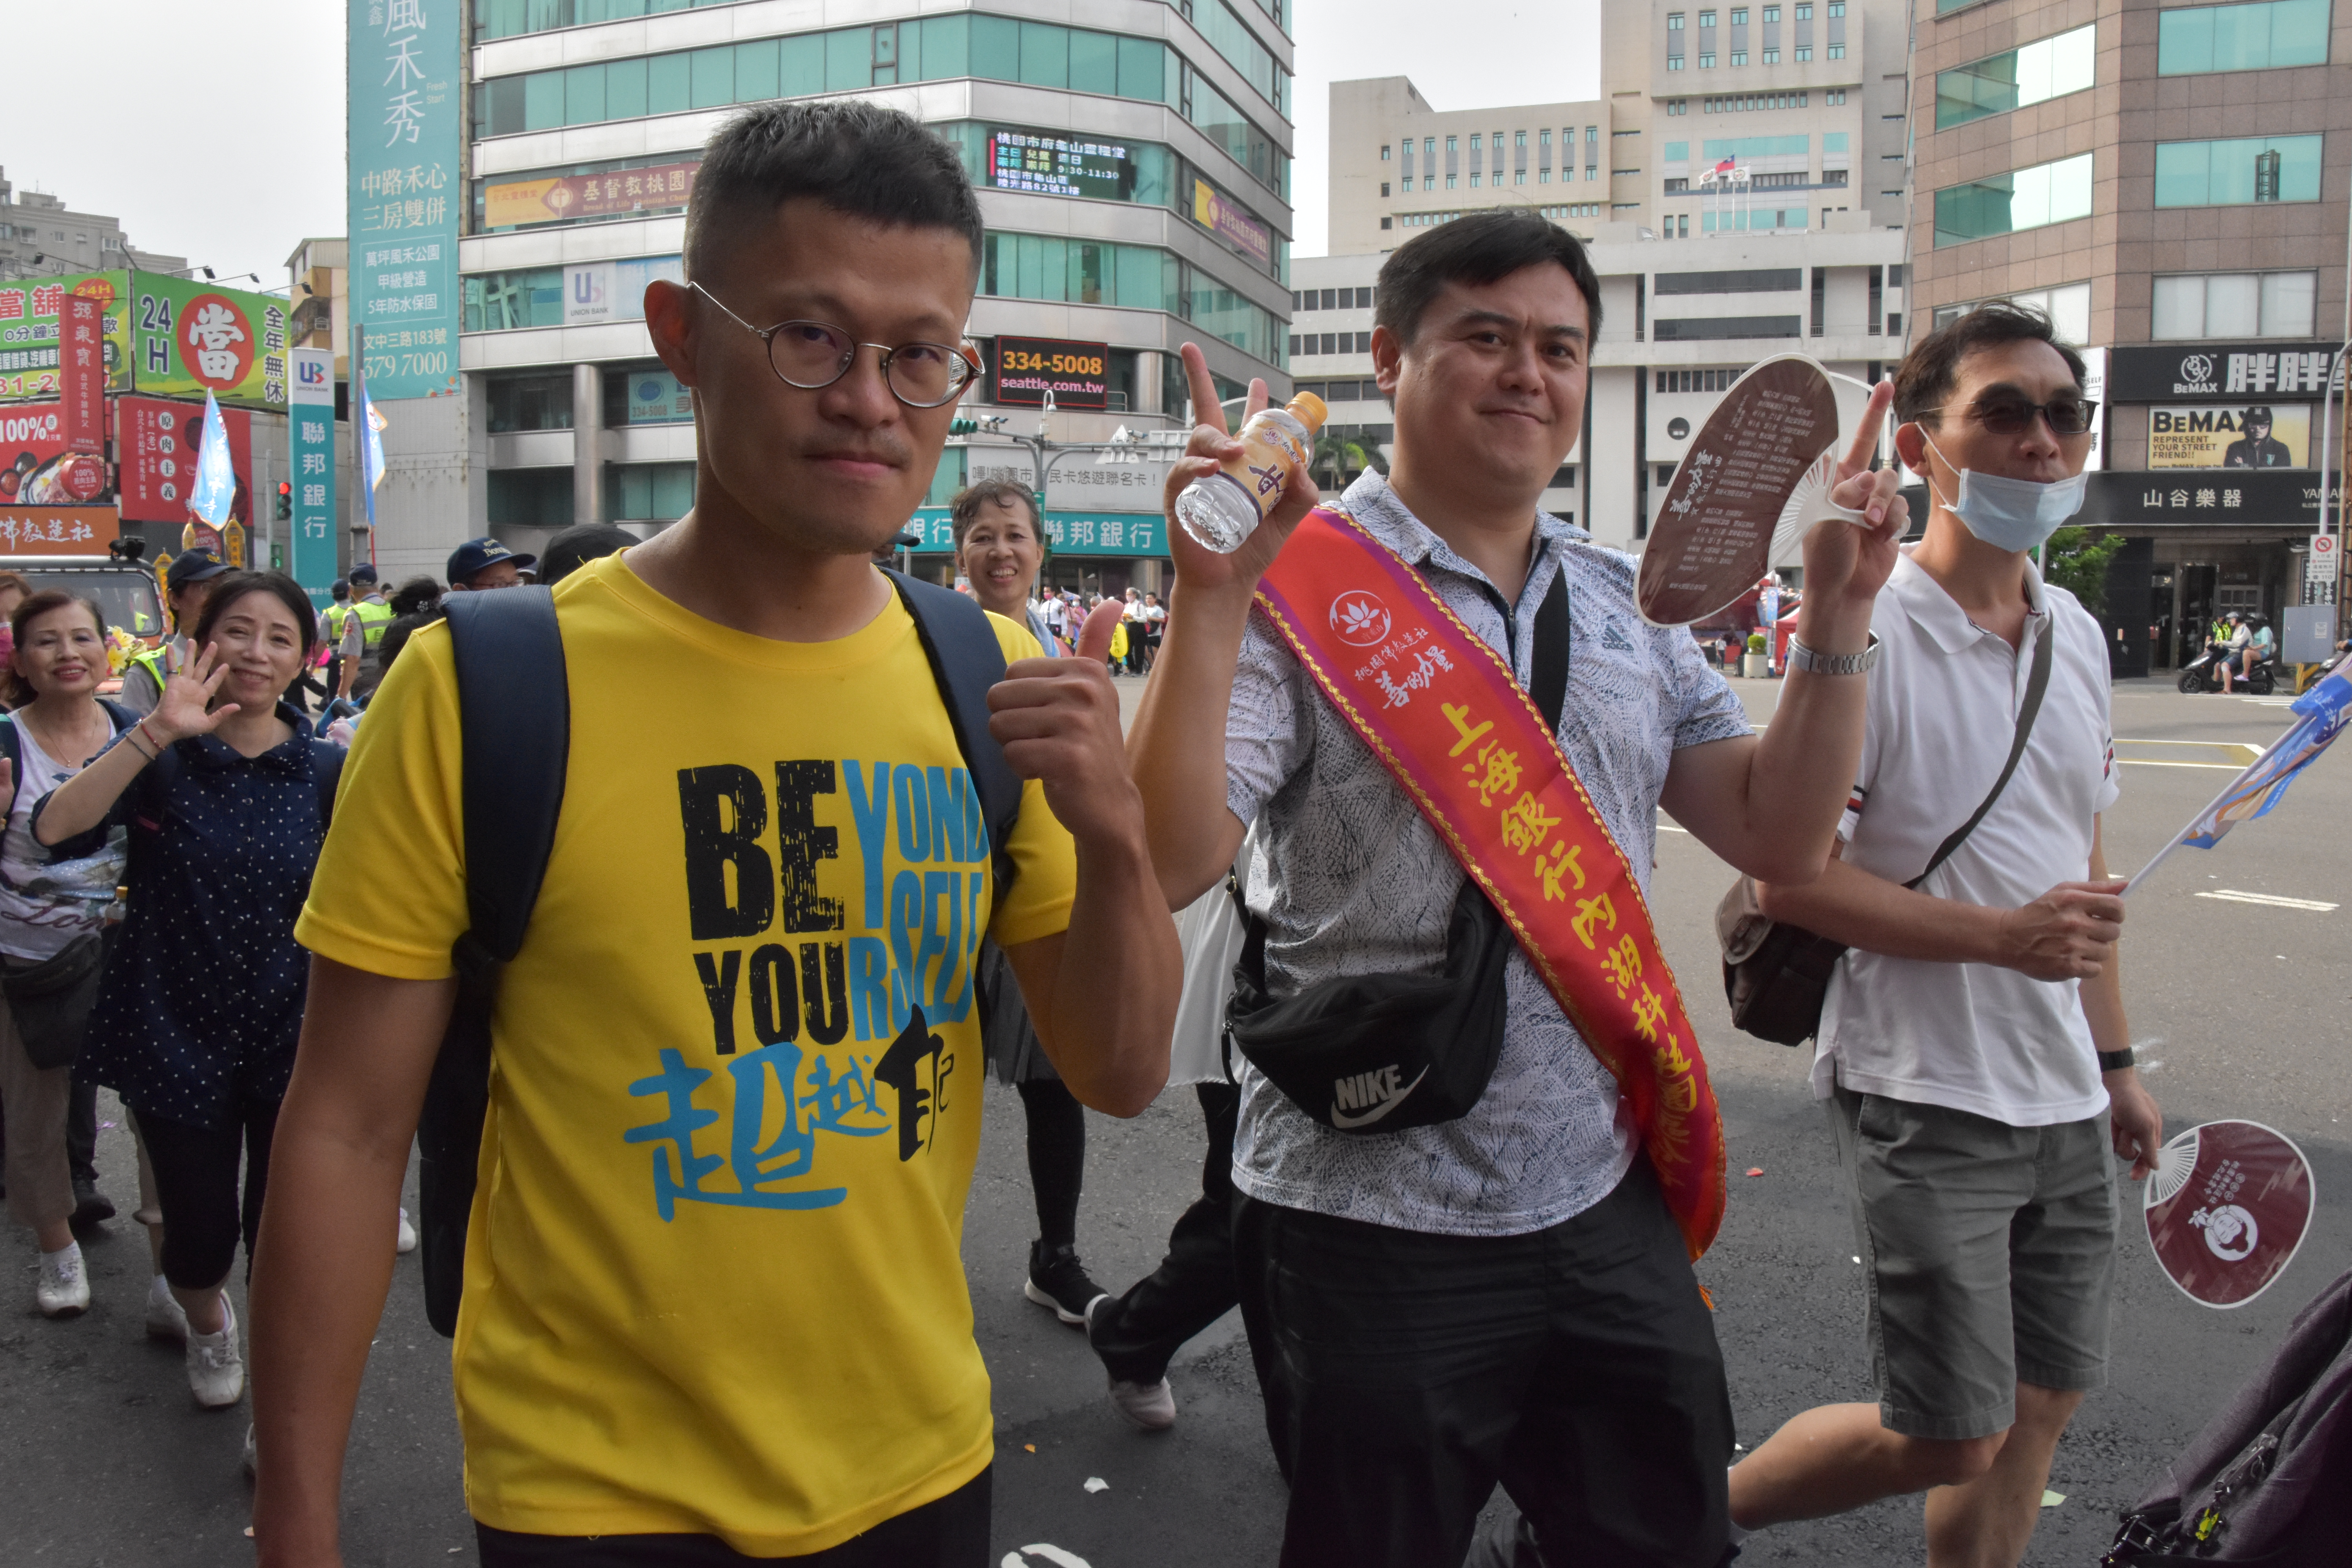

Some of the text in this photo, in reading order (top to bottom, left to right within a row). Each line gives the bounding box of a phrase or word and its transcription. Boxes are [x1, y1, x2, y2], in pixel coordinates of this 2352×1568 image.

[383, 0, 426, 148] 風禾秀
[426, 80, 448, 91] Fresh
[426, 94, 445, 104] Start
[361, 162, 447, 198] 中路禾心
[583, 170, 699, 201] 基督教桃園
[361, 196, 447, 231] 三房雙併
[366, 244, 440, 268] 萬坪風禾公園
[77, 284, 111, 296] 24H
[378, 271, 427, 290] 甲級營造
[141, 296, 171, 332] 24
[368, 294, 437, 314] 5年防水保固
[189, 303, 245, 381] 當
[363, 327, 447, 350] 文中三路183號
[147, 337, 169, 374] H
[264, 305, 285, 403] 全年無休
[364, 351, 447, 379] 379 7000
[1003, 351, 1102, 375] 334-5008
[1001, 377, 1104, 393] seattle.com.tw
[0, 416, 47, 443] 100%
[160, 414, 176, 501] 原肉主義
[301, 421, 326, 538] 聯邦銀行
[2143, 489, 2242, 508] 山谷樂器
[1044, 520, 1153, 548] 聯邦銀行
[1355, 628, 1429, 681] 桃園佛教蓮社
[1602, 642, 1634, 651] adidas
[1375, 645, 1454, 709] 善的力量
[1335, 1064, 1405, 1111] NIKE
